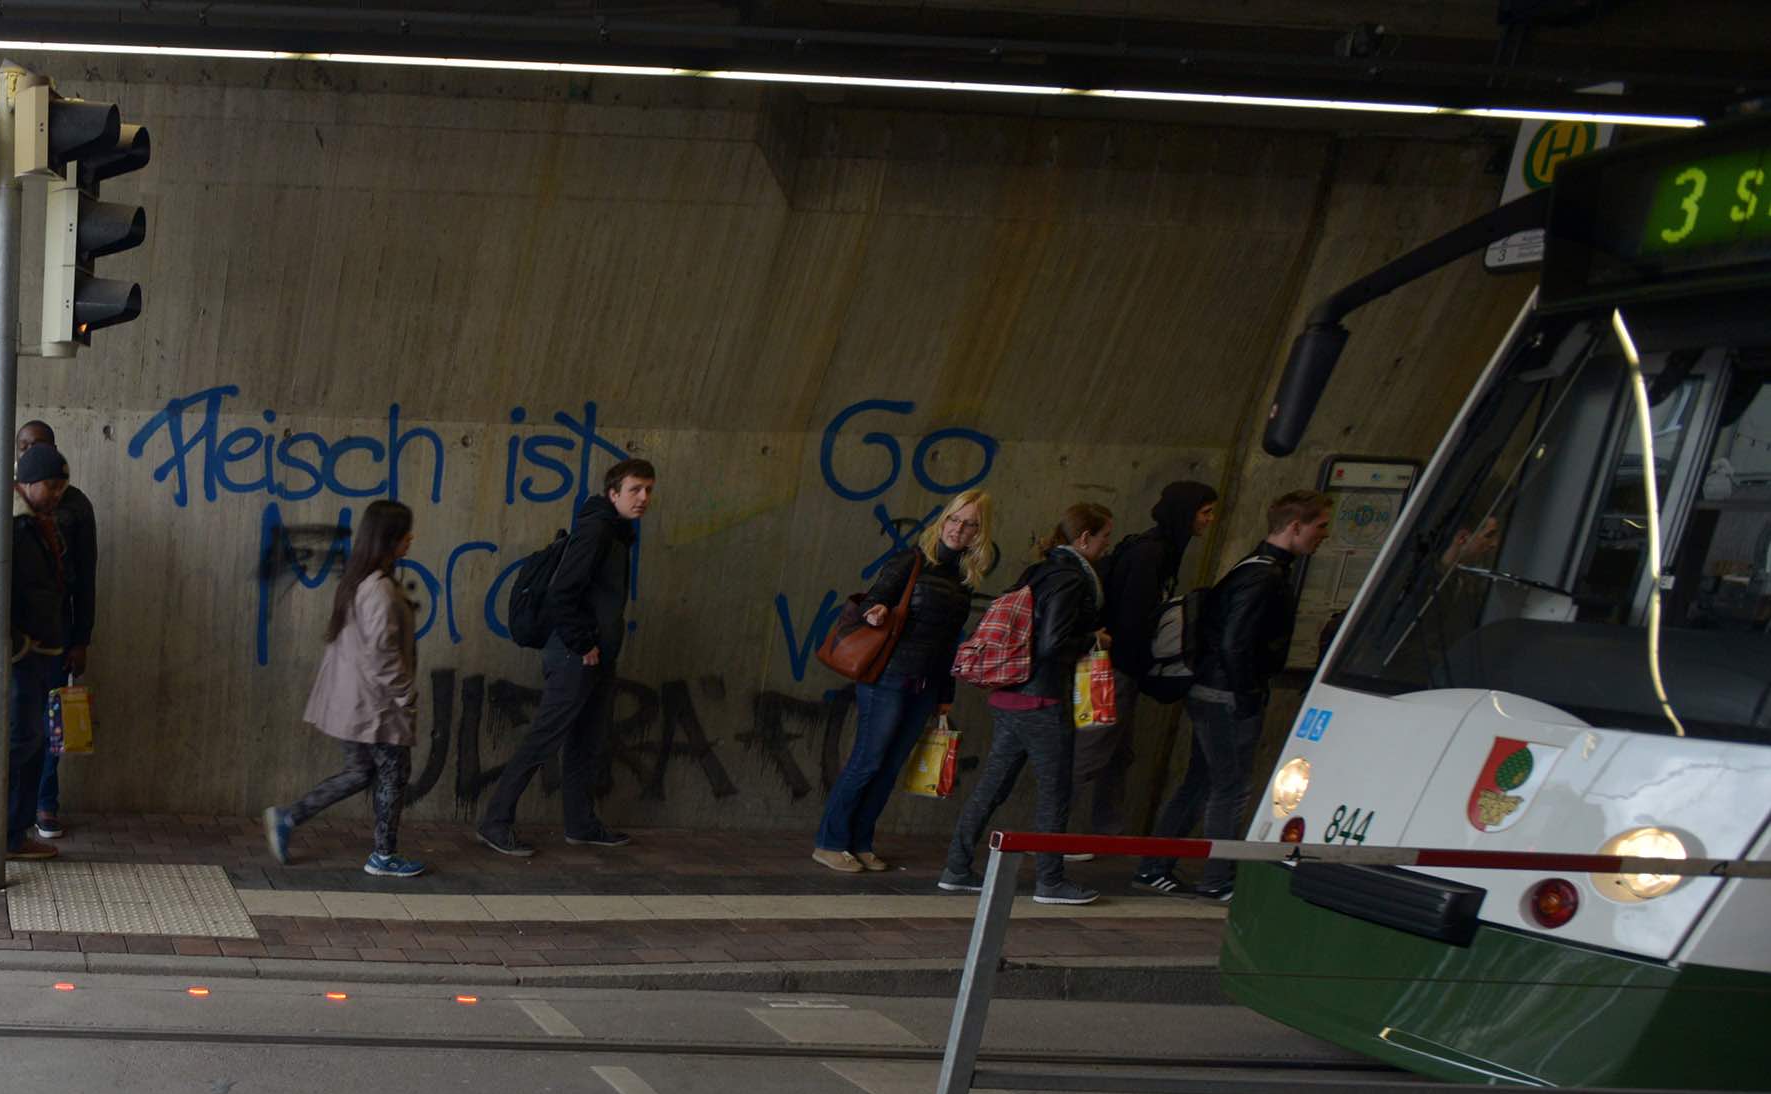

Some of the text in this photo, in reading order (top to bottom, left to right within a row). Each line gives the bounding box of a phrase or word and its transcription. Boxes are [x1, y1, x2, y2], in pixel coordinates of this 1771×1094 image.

[1660, 167, 1707, 243] 3
[129, 384, 631, 508] Fleisch ist
[819, 399, 1000, 501] Go
[1324, 804, 1375, 847] 844
